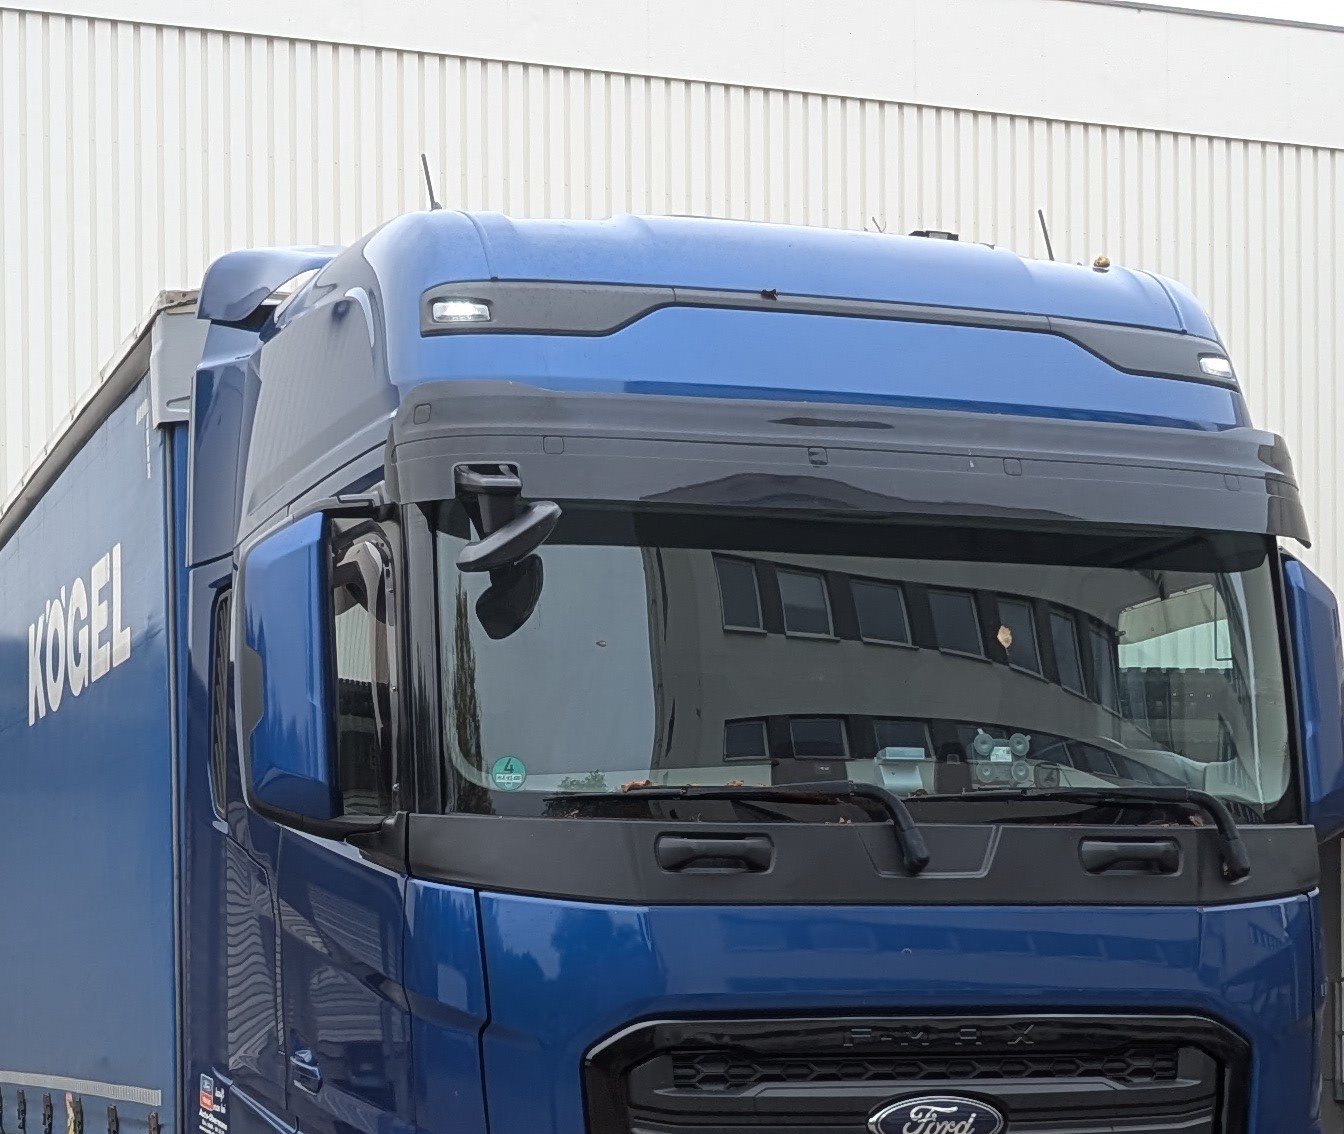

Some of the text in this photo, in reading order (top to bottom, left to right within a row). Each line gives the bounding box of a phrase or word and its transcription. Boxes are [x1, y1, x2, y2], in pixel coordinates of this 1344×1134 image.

[28, 542, 131, 727] KÖGEL
[504, 757, 515, 774] 4
[842, 1024, 1035, 1047] F-MAX
